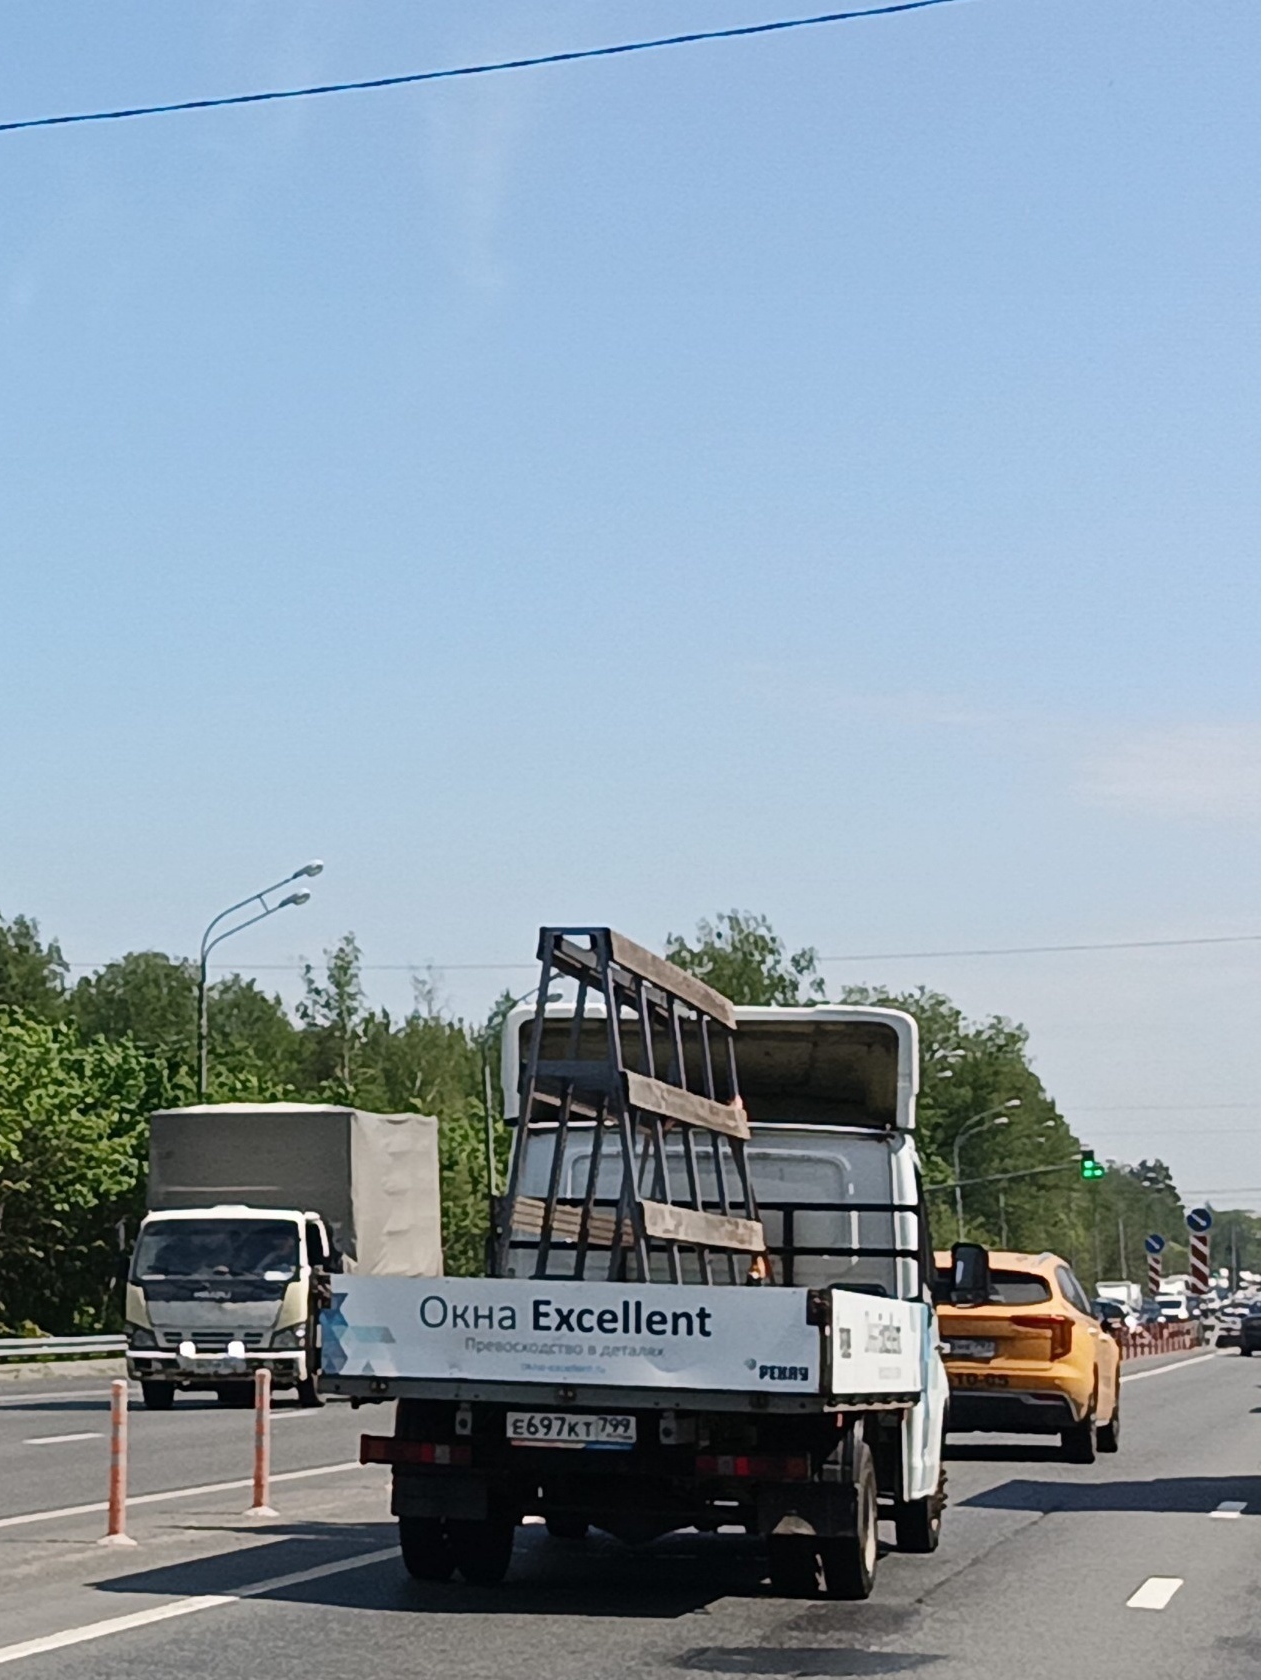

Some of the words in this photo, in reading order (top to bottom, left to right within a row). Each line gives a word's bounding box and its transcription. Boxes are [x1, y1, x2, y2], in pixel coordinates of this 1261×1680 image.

[419, 1295, 517, 1331] Окна
[531, 1299, 713, 1338] Excellent
[511, 1414, 594, 1438] Е697КТ
[597, 1416, 632, 1434] 799
